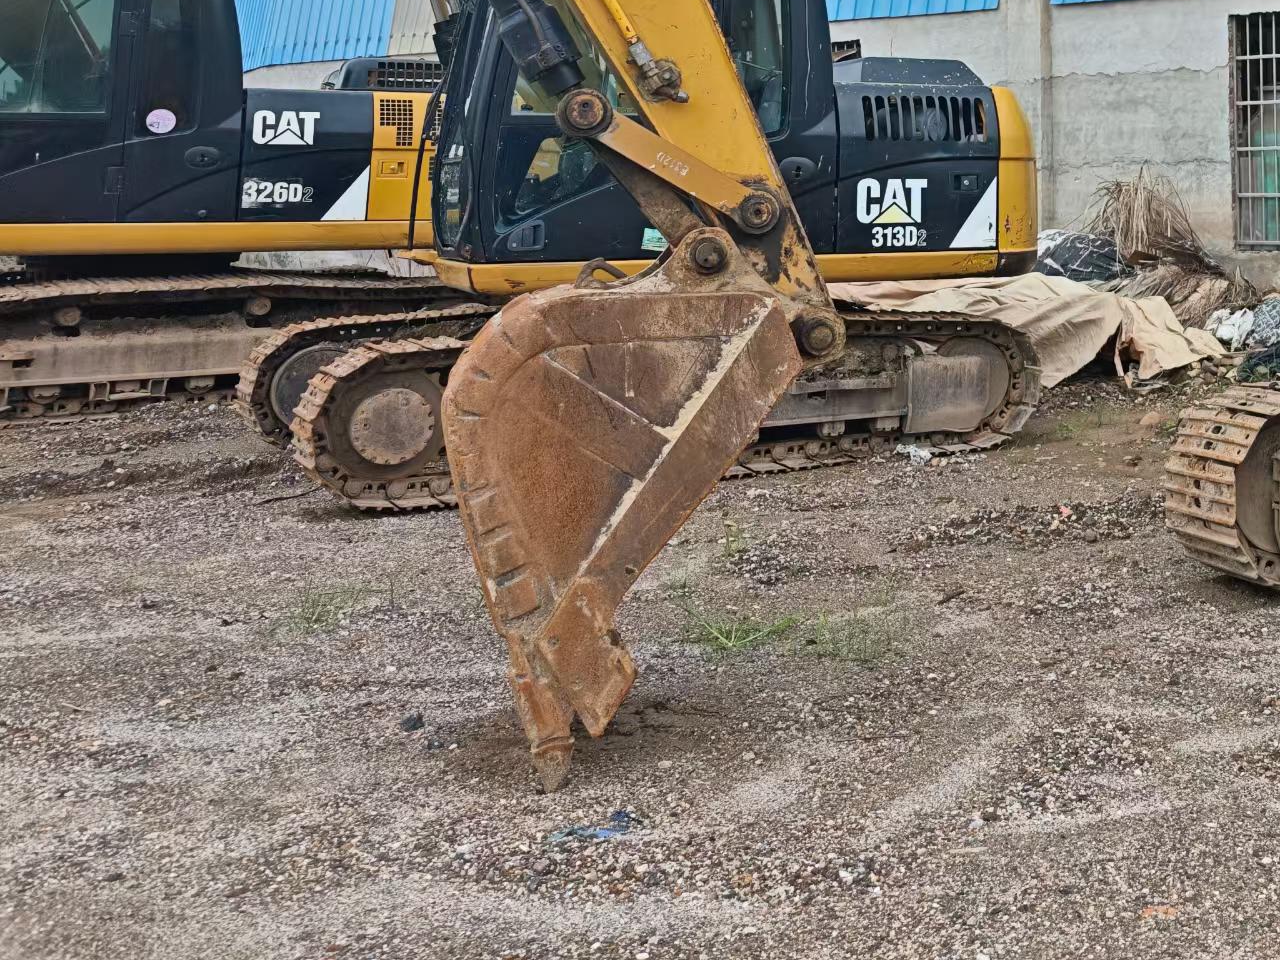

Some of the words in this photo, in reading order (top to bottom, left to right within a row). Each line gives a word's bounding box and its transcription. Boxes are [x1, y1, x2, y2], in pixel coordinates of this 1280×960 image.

[252, 110, 320, 145] CAT
[242, 180, 314, 203] 326D2
[856, 177, 928, 224] CAT
[871, 225, 927, 248] 313D2
